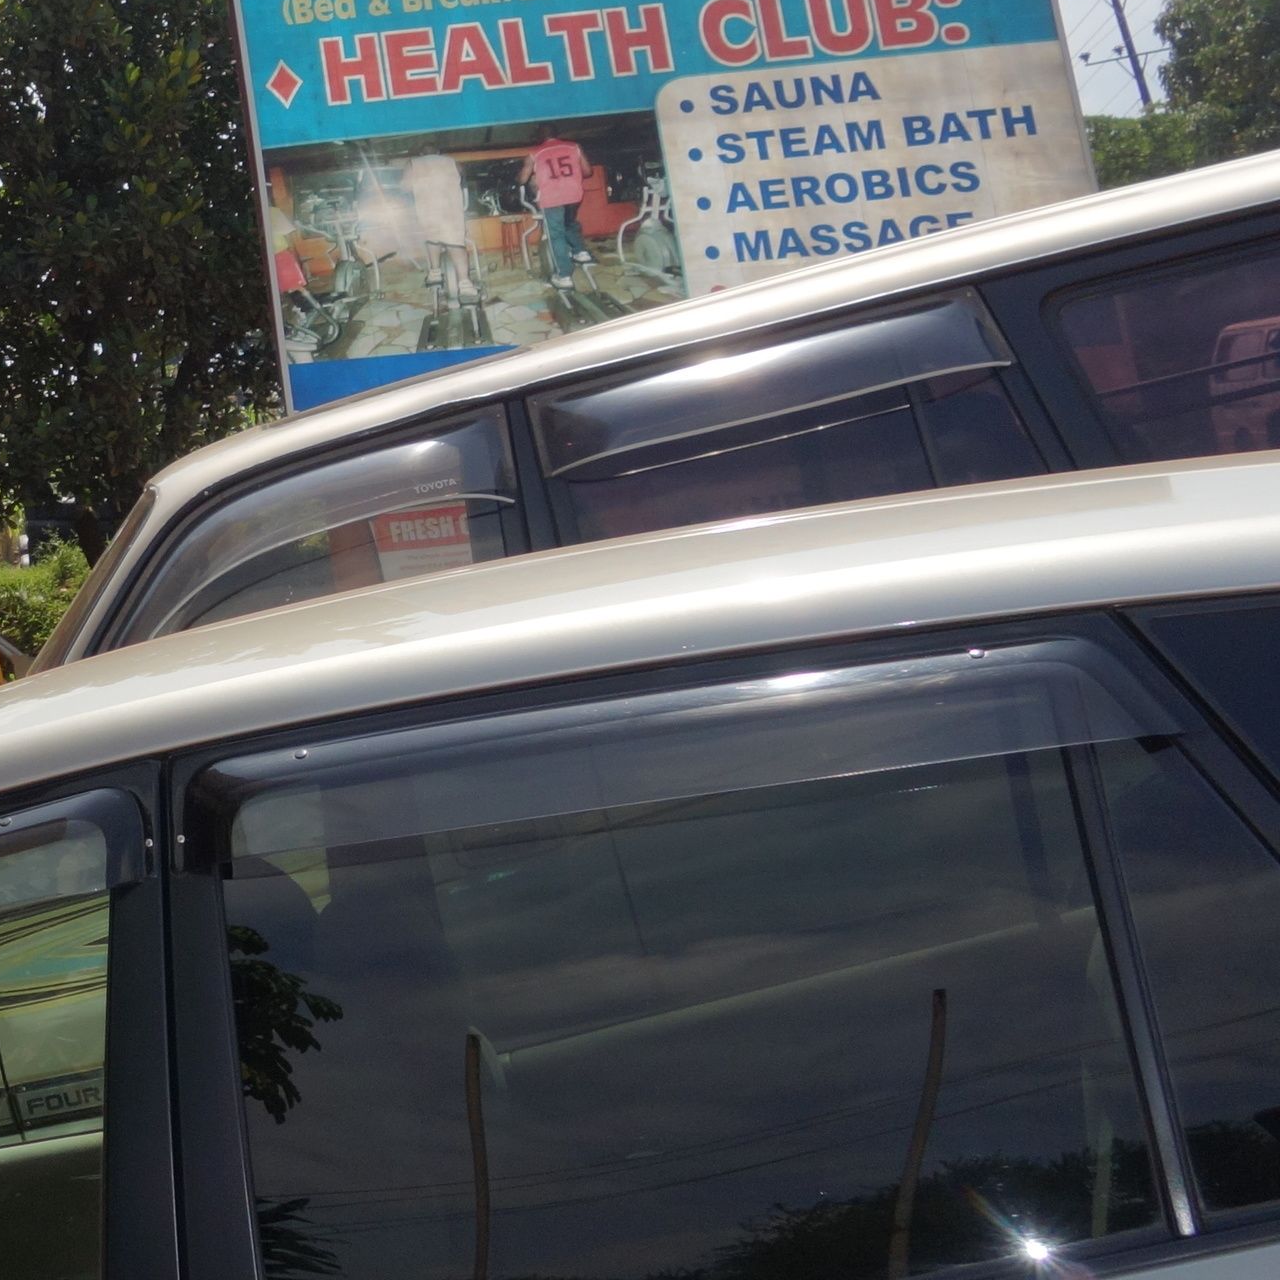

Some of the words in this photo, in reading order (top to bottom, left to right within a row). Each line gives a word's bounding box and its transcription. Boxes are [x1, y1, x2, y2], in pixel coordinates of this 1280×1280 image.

[709, 71, 882, 117] SAUNA
[716, 117, 887, 165] STEAM
[904, 105, 1039, 149] BATH
[545, 154, 574, 181] 15
[725, 160, 982, 215] AEROBICS
[413, 477, 458, 495] TOYOTA
[390, 514, 455, 544] FRESH
